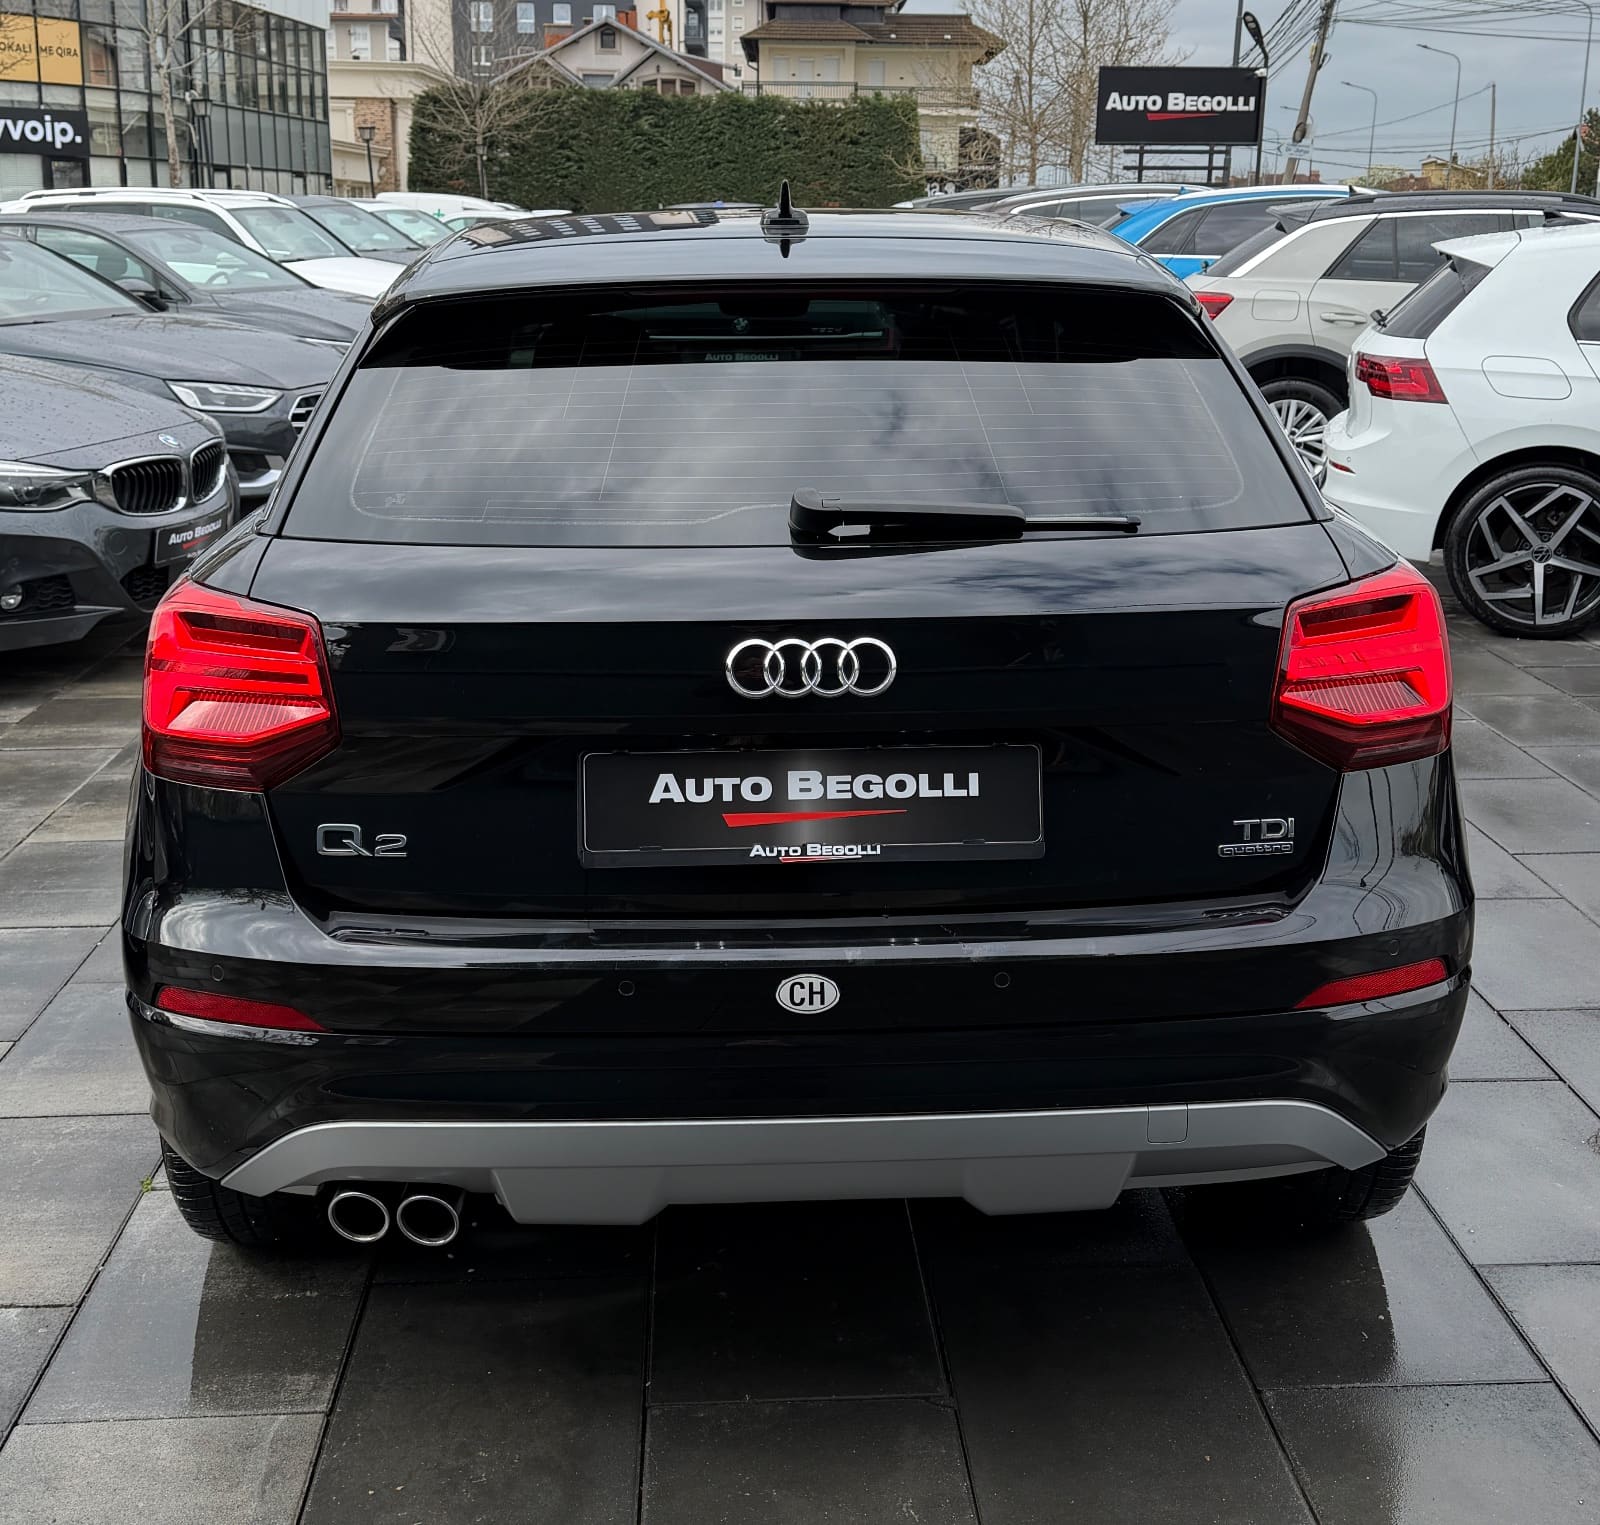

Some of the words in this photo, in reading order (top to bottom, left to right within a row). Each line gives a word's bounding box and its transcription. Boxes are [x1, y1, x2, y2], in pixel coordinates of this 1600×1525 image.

[40, 46, 54, 56] ME
[56, 46, 79, 58] QIRA
[1105, 92, 1163, 111] AUTO
[1167, 92, 1255, 112] BEGOLLI
[168, 530, 194, 546] AUTO
[649, 773, 773, 804] AUTO
[787, 770, 979, 801] BEGOLLI
[1233, 817, 1295, 840] TDI
[316, 823, 407, 857] Q2
[1218, 841, 1294, 857] quattro
[749, 844, 802, 858] AUTO
[806, 843, 882, 857] BEGOLLI
[789, 981, 826, 1007] CH
